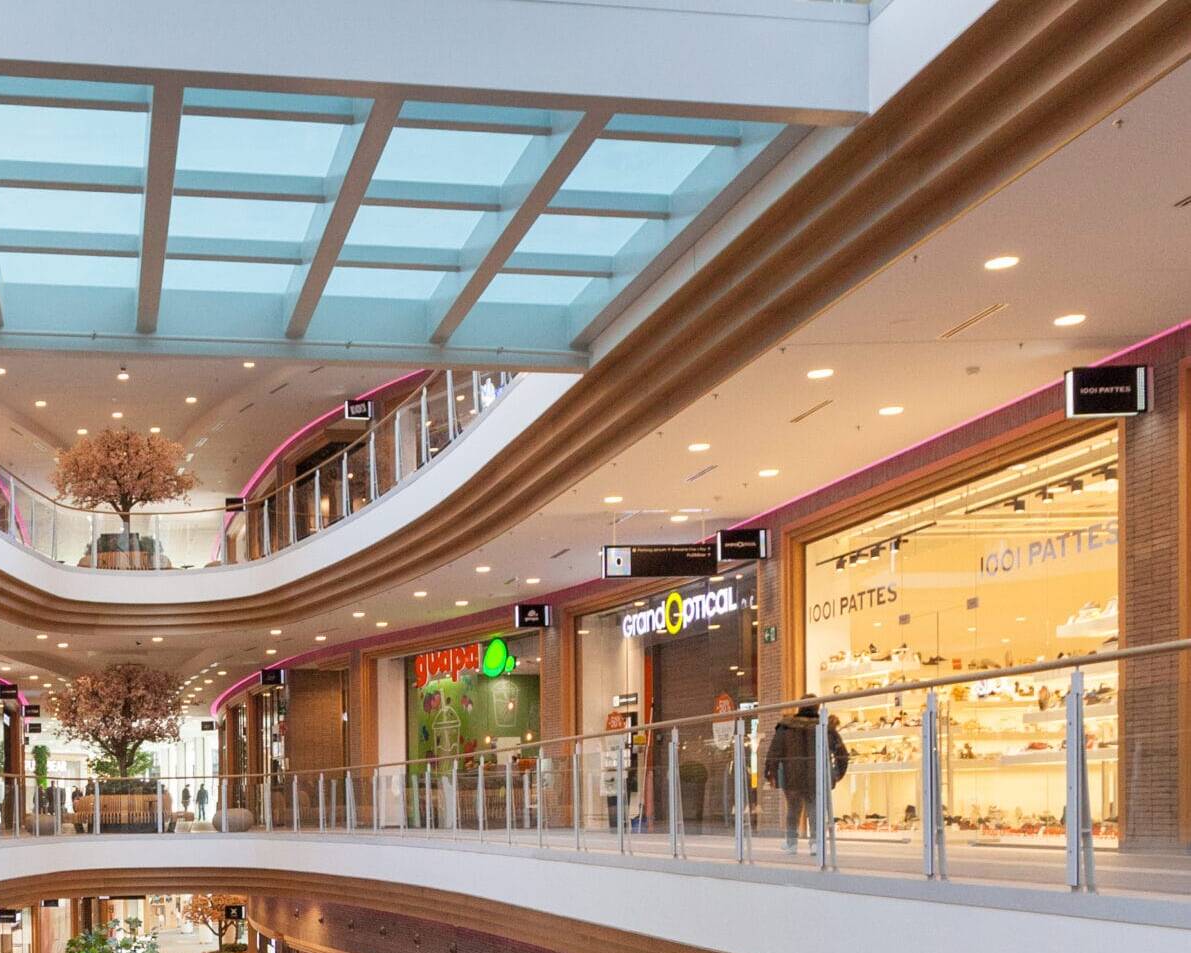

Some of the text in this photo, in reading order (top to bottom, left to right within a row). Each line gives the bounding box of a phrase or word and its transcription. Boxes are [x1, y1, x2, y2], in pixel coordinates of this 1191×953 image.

[1099, 385, 1131, 393] PATTES
[1028, 519, 1118, 566] PATTES
[839, 583, 898, 615] PATTES
[413, 642, 480, 688] guapa
